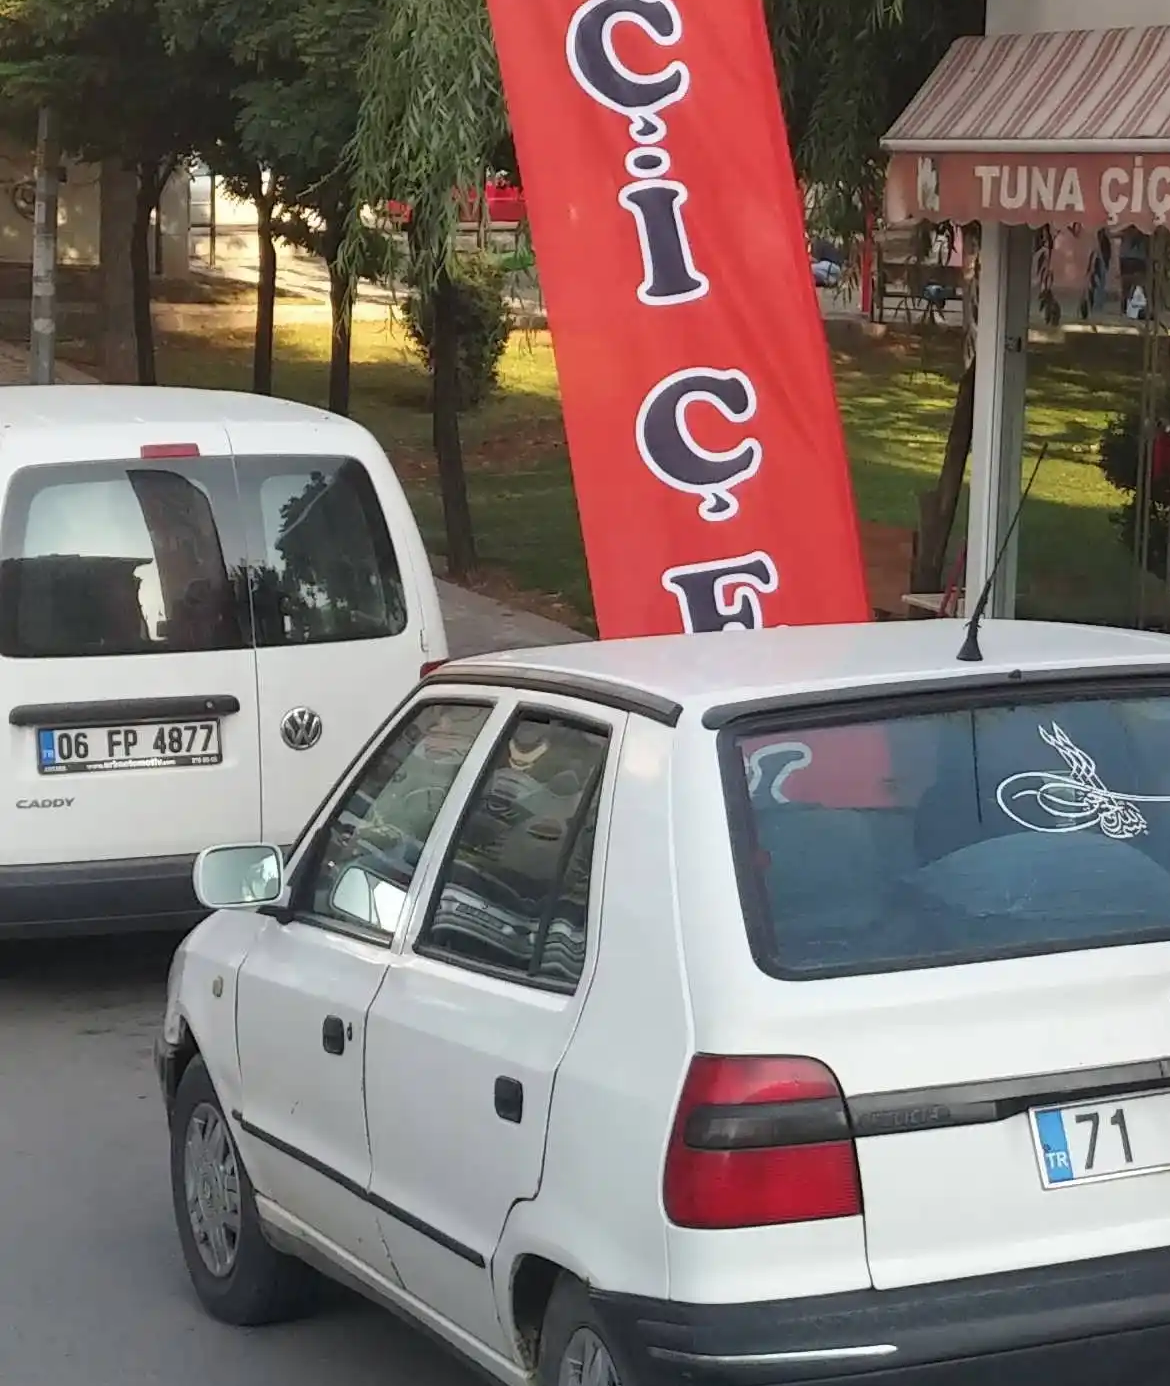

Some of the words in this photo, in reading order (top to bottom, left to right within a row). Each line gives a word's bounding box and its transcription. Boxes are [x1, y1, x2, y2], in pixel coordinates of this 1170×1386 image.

[974, 165, 1086, 212] TUNA
[58, 732, 89, 760] 06
[107, 729, 138, 757] FP
[153, 724, 213, 754] 4877
[15, 797, 75, 809] CADDY
[1045, 1151, 1071, 1169] TR
[1075, 1109, 1133, 1170] 71
